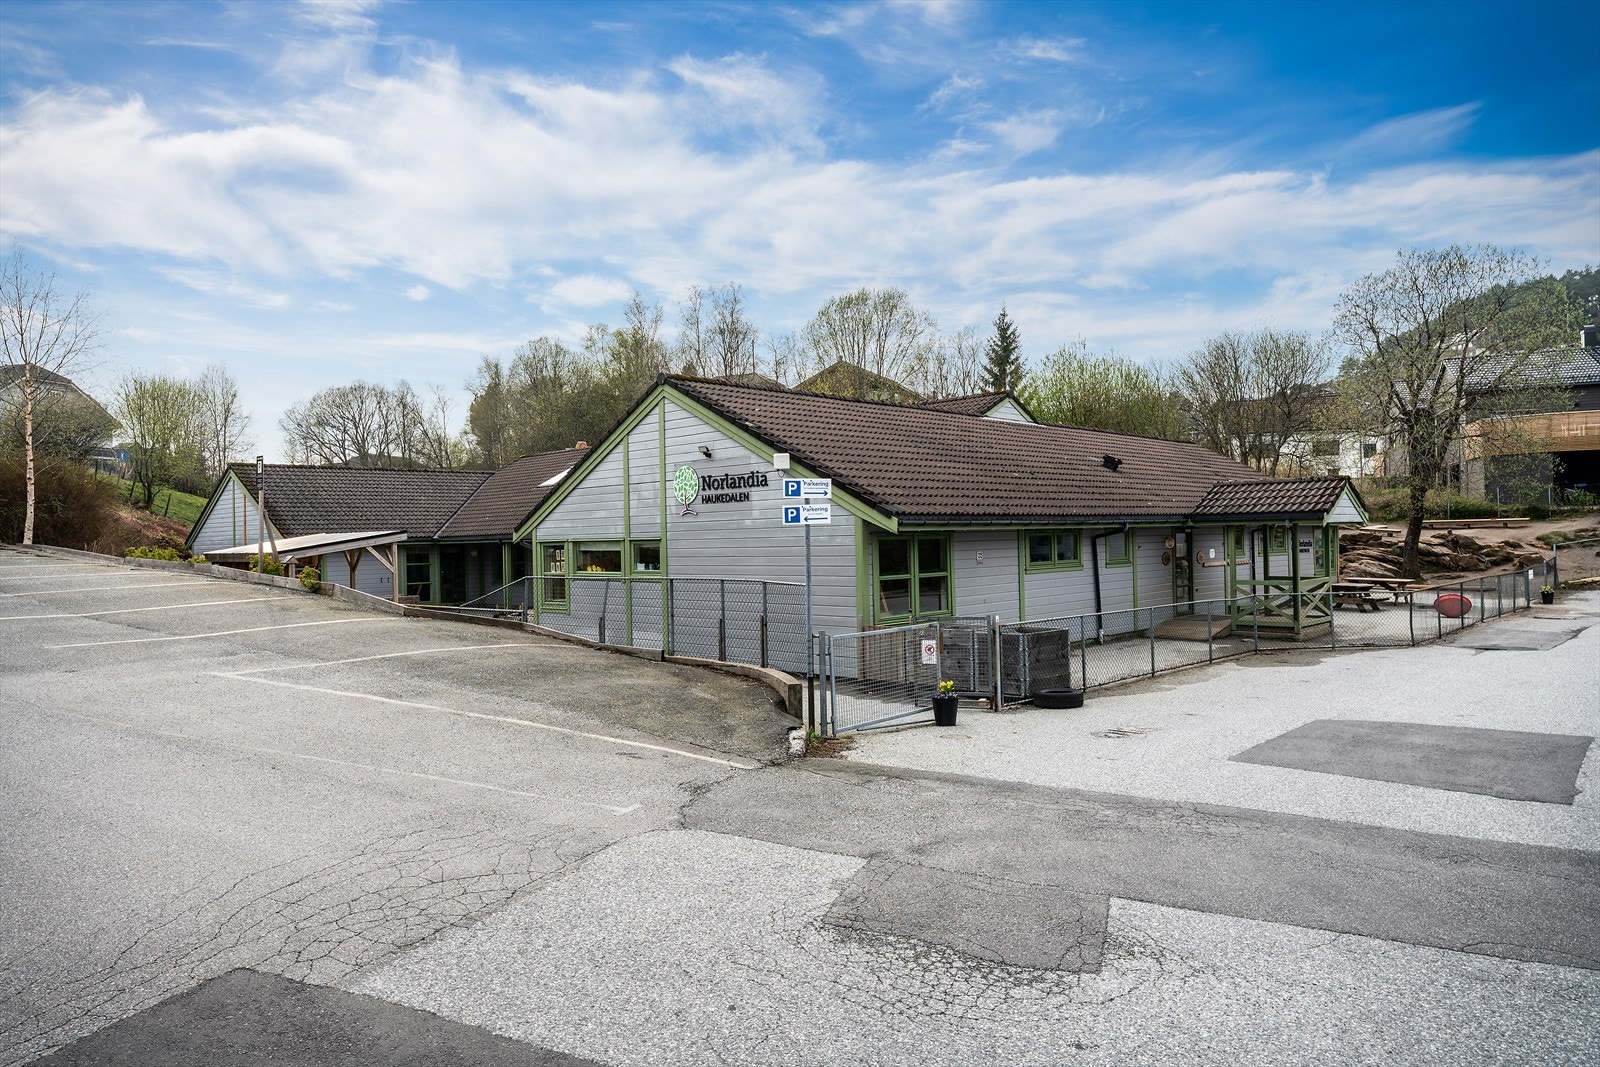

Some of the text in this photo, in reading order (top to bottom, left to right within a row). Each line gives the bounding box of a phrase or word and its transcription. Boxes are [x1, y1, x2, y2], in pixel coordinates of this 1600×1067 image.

[701, 471, 768, 491] Norlandia
[788, 482, 798, 495] P
[701, 492, 750, 504] HAUKEDALEN
[788, 509, 797, 522] P
